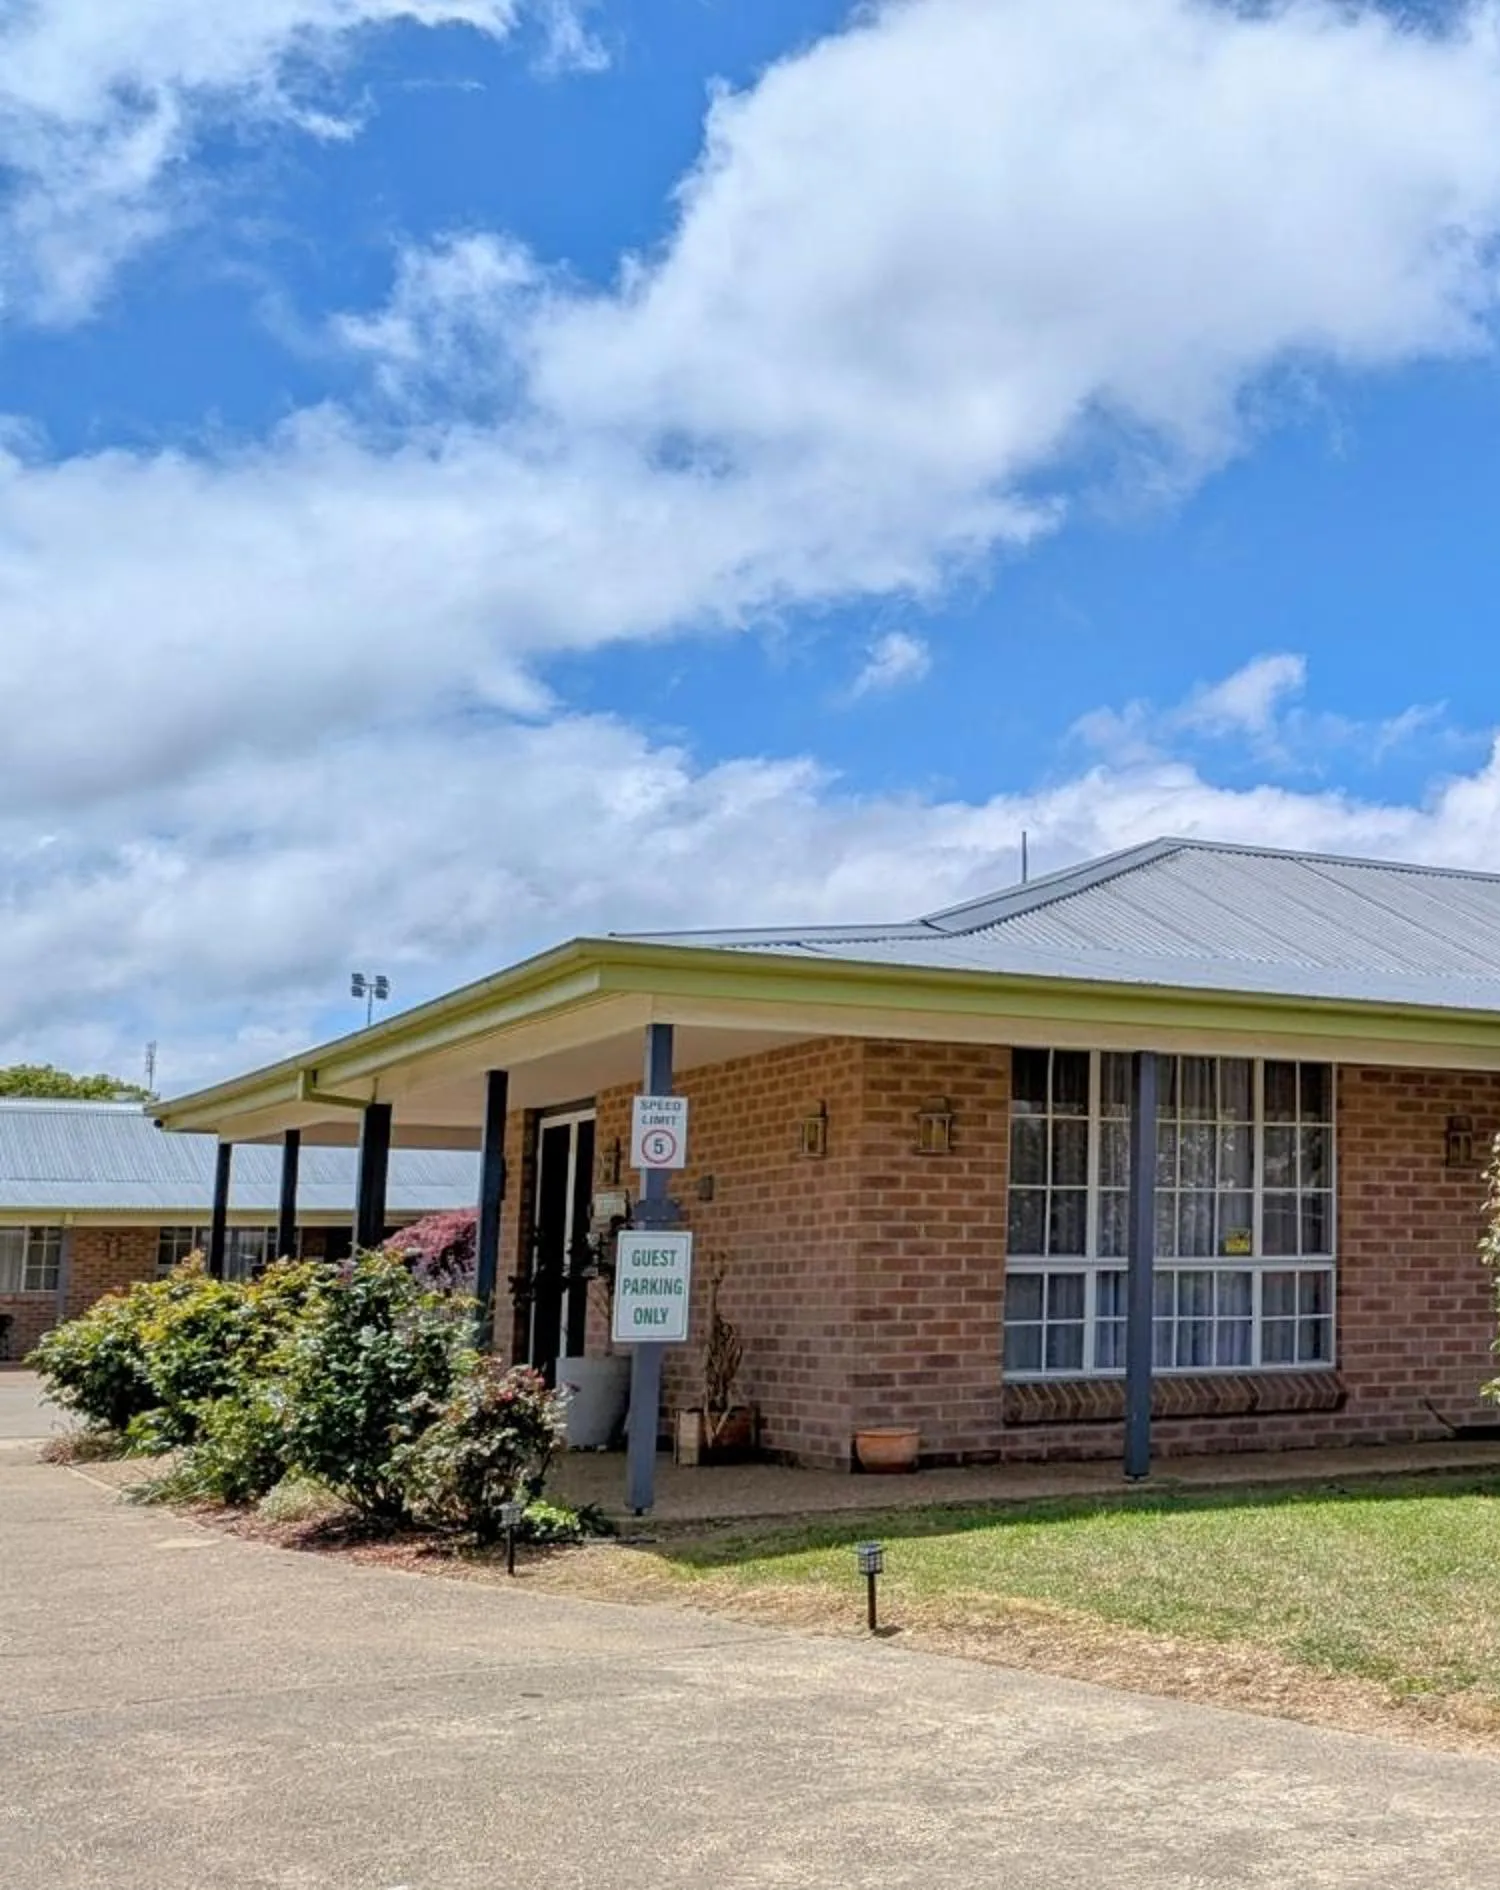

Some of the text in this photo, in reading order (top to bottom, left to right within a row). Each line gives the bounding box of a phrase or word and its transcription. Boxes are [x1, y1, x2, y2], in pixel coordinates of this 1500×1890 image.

[640, 1101, 681, 1111] SPEED
[641, 1114, 676, 1125] LIMIT
[653, 1138, 664, 1154] 5
[632, 1250, 677, 1267] GUEST
[622, 1278, 683, 1295] PARKING
[633, 1307, 669, 1325] ONLY
